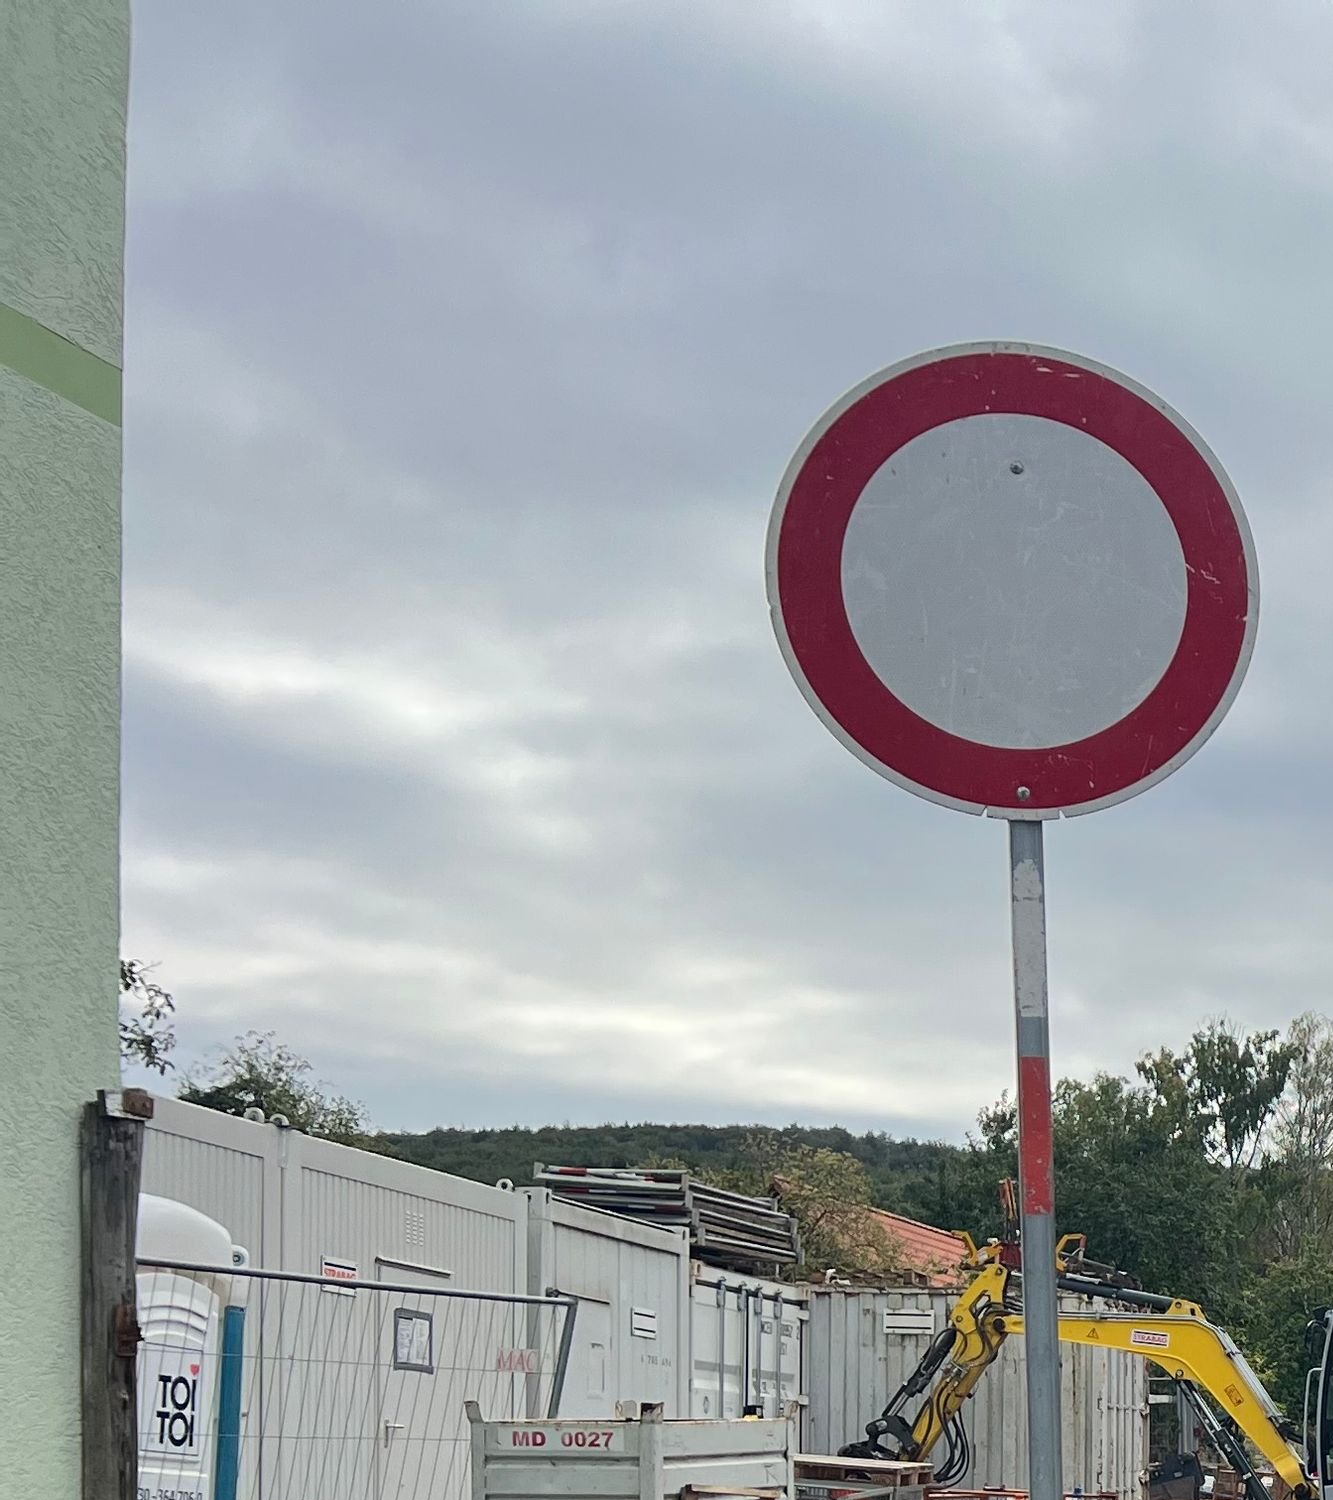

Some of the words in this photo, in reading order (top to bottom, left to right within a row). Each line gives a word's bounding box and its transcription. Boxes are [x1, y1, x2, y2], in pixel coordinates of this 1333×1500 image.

[156, 1411, 195, 1447] TOI
[512, 1431, 546, 1447] MD
[561, 1431, 614, 1449] 0027
